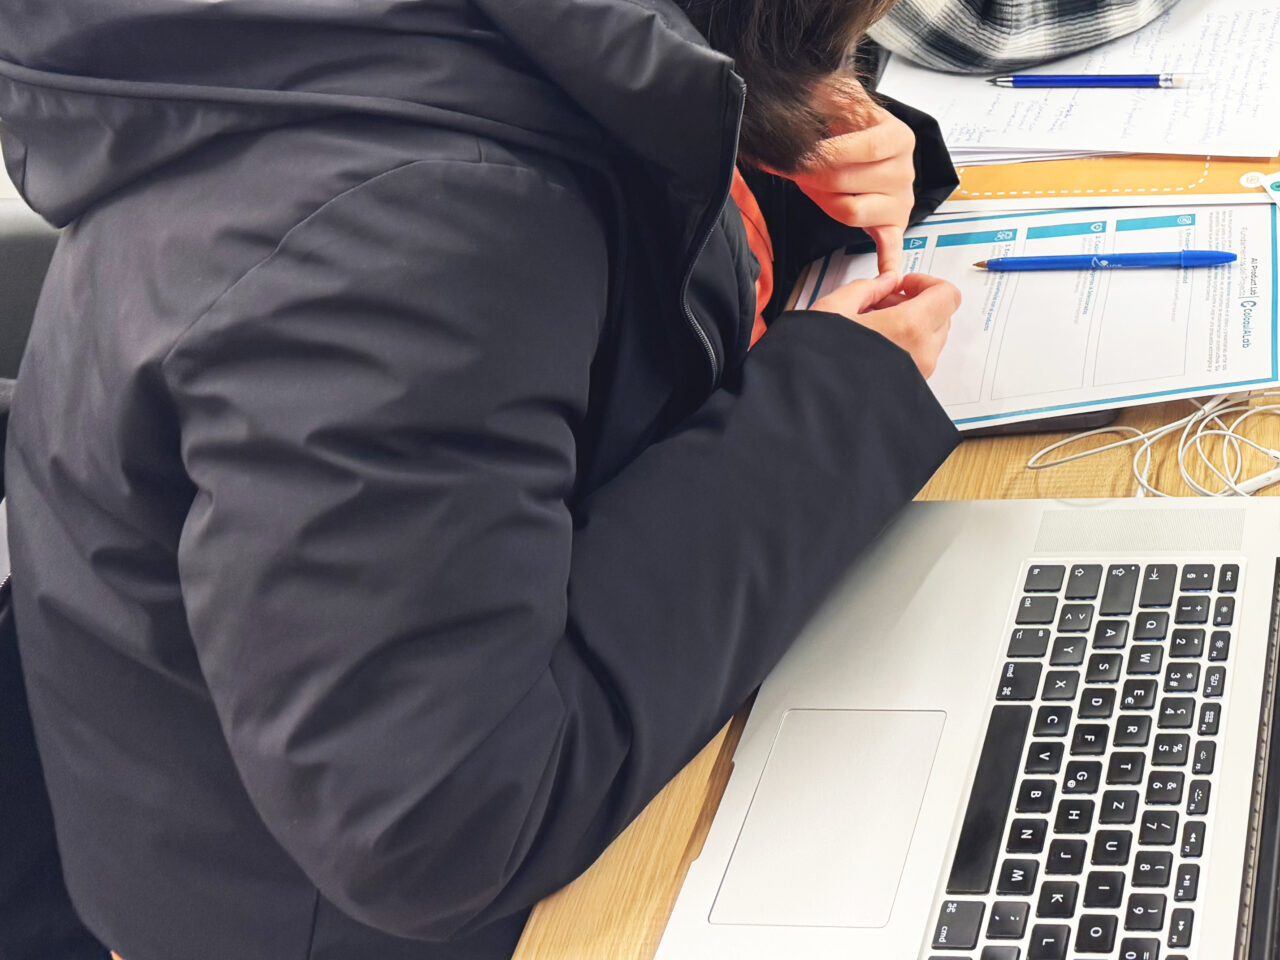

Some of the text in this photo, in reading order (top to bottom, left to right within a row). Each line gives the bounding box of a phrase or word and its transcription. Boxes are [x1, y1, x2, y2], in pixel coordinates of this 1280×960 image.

[1249, 265, 1258, 285] Product
[1250, 286, 1258, 296] Lab
[1146, 620, 1156, 629] Q
[1105, 629, 1116, 637] A
[1140, 653, 1151, 663] W
[1006, 663, 1015, 677] cmd
[1055, 680, 1066, 688] X
[1092, 698, 1102, 706] D
[1048, 716, 1058, 724] C
[1127, 725, 1138, 733] R
[1039, 752, 1050, 761] V
[1077, 772, 1087, 780] G
[1113, 801, 1124, 810] Z
[1068, 810, 1080, 820] H
[1020, 829, 1033, 839] N
[1106, 842, 1117, 851] U
[1011, 869, 1024, 882] M
[1051, 894, 1064, 903] K
[939, 926, 949, 942] cmd
[1090, 927, 1102, 937] O
